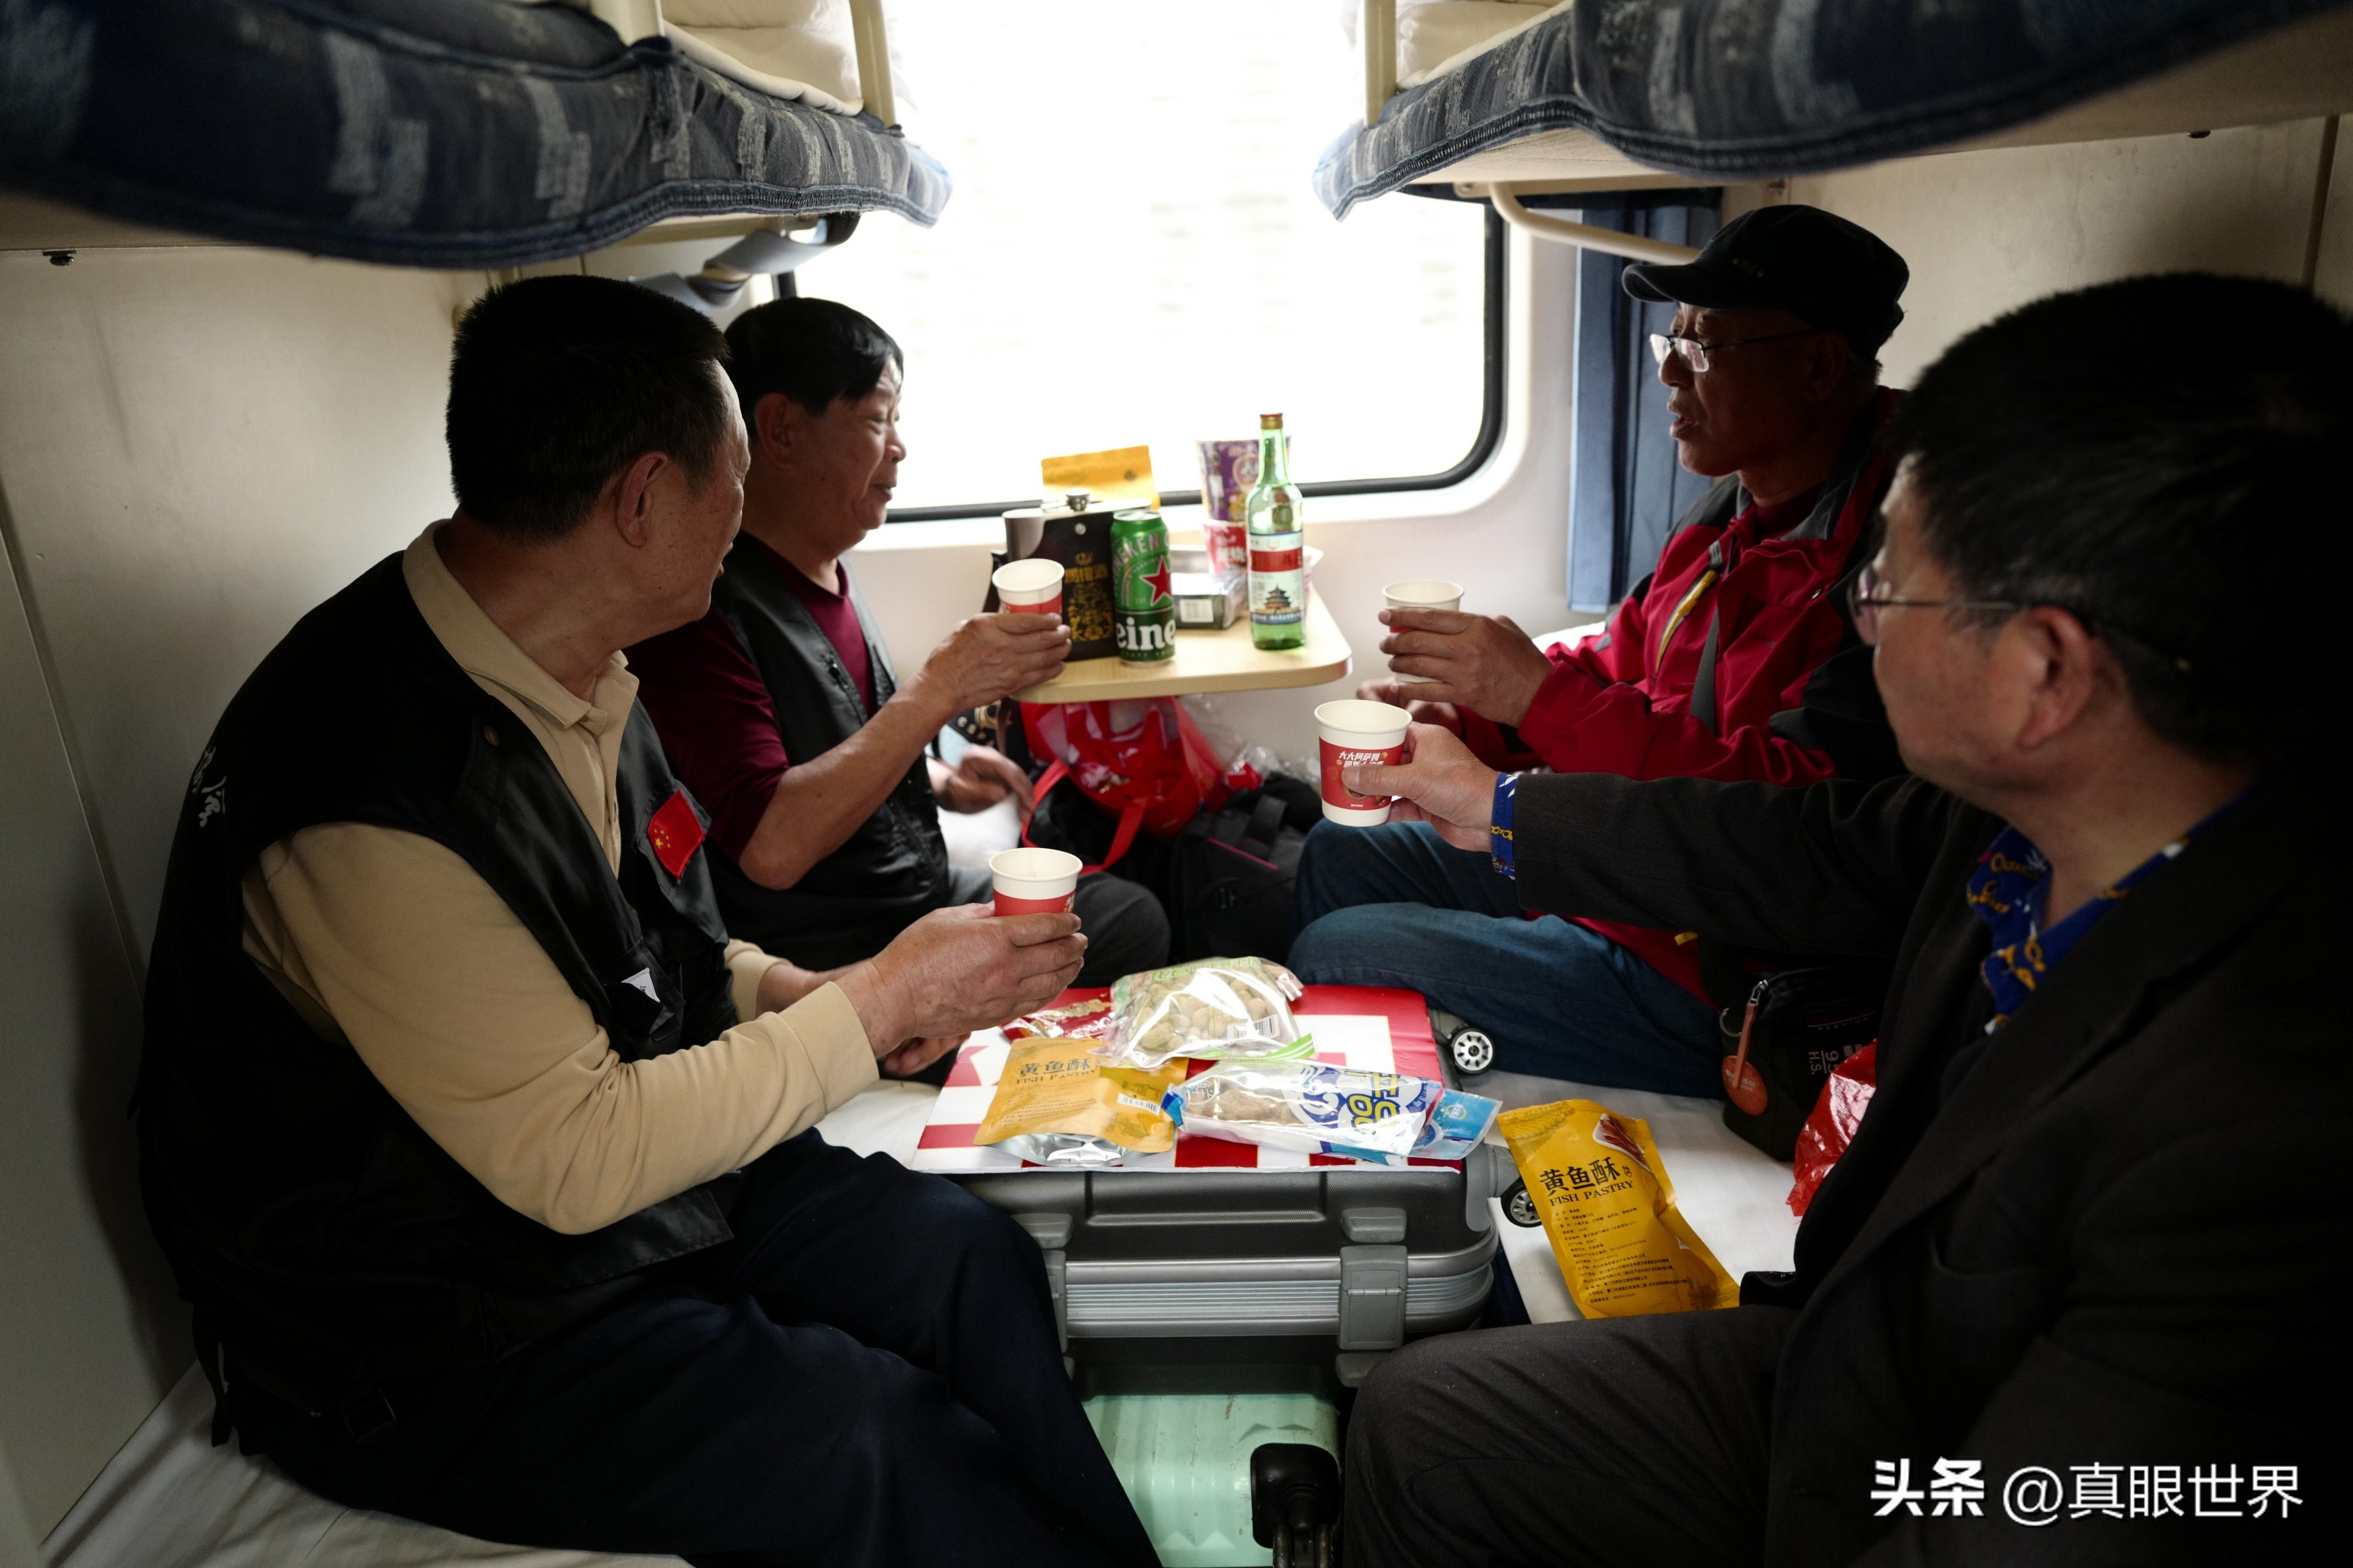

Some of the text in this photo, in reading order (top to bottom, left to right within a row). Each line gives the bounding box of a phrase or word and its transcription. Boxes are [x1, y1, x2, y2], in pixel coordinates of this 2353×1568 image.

[1339, 751, 1380, 761] 大大阿萨姆
[1018, 1057, 1092, 1077] 黄鱼酥
[1016, 1076, 1044, 1084] FISH
[1049, 1070, 1097, 1080] PASTRY
[1539, 1156, 1621, 1197] 黄鱼酥
[1583, 1181, 1634, 1200] PASTRY
[1549, 1193, 1580, 1207] FISH
